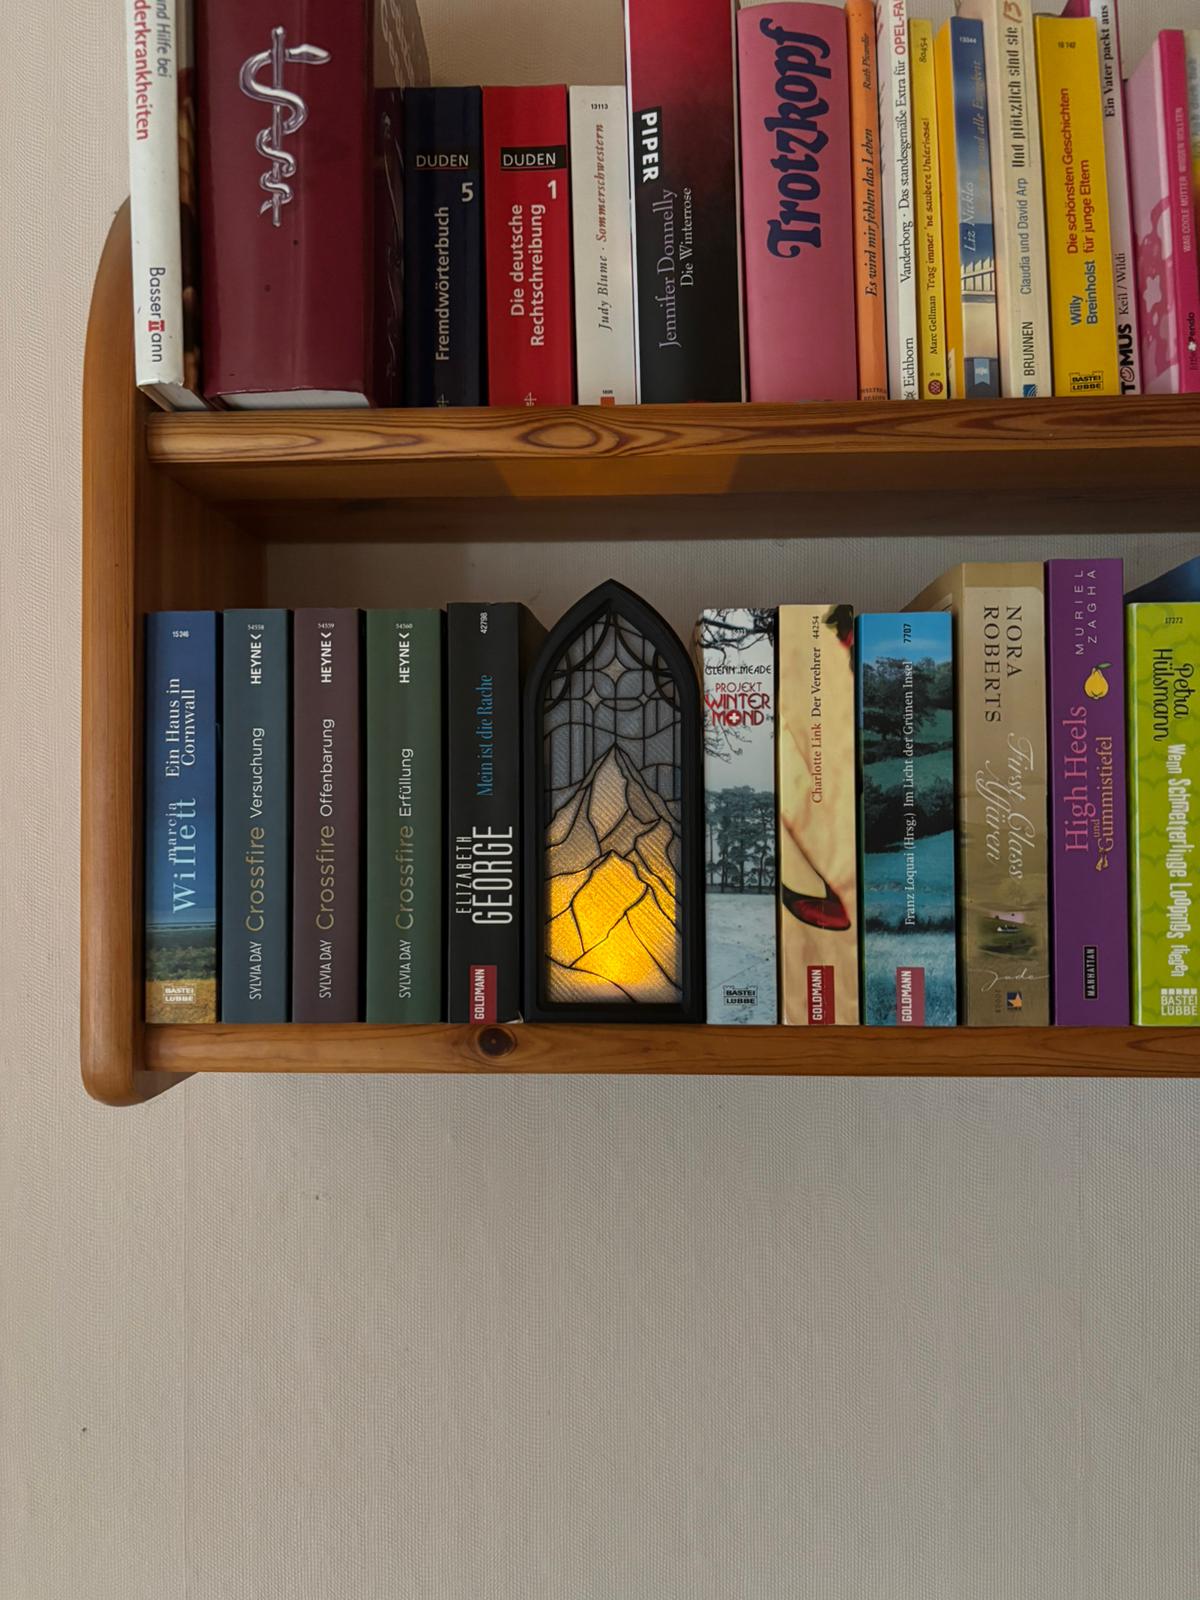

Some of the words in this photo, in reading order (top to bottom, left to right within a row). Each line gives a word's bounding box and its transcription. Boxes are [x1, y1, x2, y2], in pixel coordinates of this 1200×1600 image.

[893, 0, 906, 55] OPEL-FA
[1101, 5, 1110, 24] aus
[157, 24, 171, 54] Hilfe
[1005, 26, 1020, 46] sie
[1100, 28, 1115, 60] packt
[157, 58, 172, 78] bei
[893, 60, 906, 79] für
[1006, 50, 1021, 76] sind
[1102, 63, 1115, 96] Vater
[896, 80, 907, 107] Extra
[1008, 80, 1026, 140] plötzlich
[1104, 97, 1116, 118] Ein
[760, 18, 832, 258] Trotzkopf
[861, 128, 873, 161] Leben
[1060, 88, 1073, 165] Geschichten
[415, 154, 469, 167] DUDEN
[503, 153, 556, 166] DUDEN
[641, 111, 659, 183] PIPER
[896, 110, 912, 186] standesgemäße
[1011, 144, 1026, 168] Und
[461, 182, 474, 202] 5
[547, 180, 557, 199] 1
[594, 123, 608, 242] Sommerschwestern
[862, 162, 875, 186] das
[923, 169, 933, 211] saubere
[1016, 177, 1029, 197] Arp
[1080, 160, 1092, 192] Eltern
[863, 186, 880, 225] fehlen
[898, 189, 909, 209] Das
[961, 182, 976, 226] Nickles
[1017, 199, 1029, 228] David
[1062, 167, 1078, 231] schönsten
[1081, 194, 1096, 232] junge
[653, 189, 677, 275] Donnelly
[680, 187, 693, 260] Winterrose
[864, 226, 876, 247] mir
[964, 231, 976, 251] Liz
[1018, 229, 1030, 253] und
[508, 205, 524, 282] deutsche
[899, 221, 913, 283] Vanderborg
[925, 233, 934, 264] immer
[1067, 233, 1078, 254] Die
[1082, 234, 1094, 254] für
[434, 206, 450, 361] Fremdwörterbuch
[528, 204, 546, 346] Rechtschreibung
[597, 255, 609, 296] Blume
[680, 262, 694, 287] Die
[865, 251, 877, 280] wird
[926, 267, 937, 291] Trag
[1019, 256, 1031, 295] Claudia
[1114, 252, 1126, 281] Wildi
[510, 291, 525, 316] Die
[865, 282, 877, 296] Es
[1085, 260, 1098, 325] Breinholst
[1118, 292, 1129, 315] Keil
[148, 267, 166, 363] Bassermann
[598, 298, 613, 331] Judy
[655, 277, 681, 348] Jennifer
[928, 295, 936, 327] Gellman
[1070, 295, 1083, 325] Willy
[1187, 311, 1196, 342] Pendo
[929, 330, 938, 354] Marc
[1022, 321, 1035, 377] BRUNNEN
[904, 337, 915, 387] Eichborn
[1072, 375, 1101, 383] BASTEI
[480, 612, 488, 634] 42798
[1074, 570, 1085, 655] MURIEL
[1087, 569, 1098, 644] ZAGHA
[903, 623, 912, 643] 7707
[1006, 605, 1023, 680] NORA
[250, 642, 262, 685] HEYNE
[320, 640, 332, 683] HEYNE
[399, 640, 410, 683] HEYNE
[704, 664, 735, 675] GLENN
[740, 664, 771, 675] MEADE
[810, 647, 822, 694] Verehrer
[902, 661, 913, 688] Insel
[983, 605, 1001, 722] ROBERTS
[166, 678, 180, 694] in
[475, 674, 493, 715] Rache
[705, 693, 771, 709] WINTER
[715, 682, 762, 692] PROJEKT
[1152, 649, 1174, 741] Hülsmann
[1173, 662, 1195, 720] Petra
[165, 700, 180, 742] Haus
[712, 710, 765, 727] MOND
[811, 695, 822, 717] Der
[902, 693, 914, 735] Grünen
[181, 689, 195, 766] Cornwall
[476, 718, 493, 740] die
[811, 723, 822, 747] Link
[1063, 706, 1088, 780] Heels
[165, 751, 180, 777] Ein
[477, 743, 493, 759] ist
[903, 737, 914, 757] der
[1166, 743, 1186, 774] Wenn
[250, 727, 265, 818] Versuchung
[319, 719, 335, 817] Offenbarung
[399, 748, 414, 817] Erfüllung
[476, 762, 493, 796] Mein
[811, 751, 822, 804] Charlotte
[903, 761, 914, 790] Licht
[1007, 732, 1034, 801] First
[903, 793, 914, 807] Im
[1096, 736, 1114, 852] Gummistiefel
[903, 812, 917, 850] (Hrsg.)
[975, 760, 1011, 866] Affären
[1064, 786, 1096, 851] High
[1091, 819, 1100, 838] und
[1166, 778, 1194, 878] Schmetterlinge
[165, 802, 177, 863] marcia
[1007, 812, 1035, 880] Class
[173, 798, 196, 914] Willett
[904, 852, 917, 890] Loquai
[246, 826, 265, 932] Crossfire
[316, 825, 335, 930] Crossfire
[395, 825, 414, 930] Crossfire
[456, 836, 472, 914] ELIZABETH
[472, 826, 513, 925] GEORGE
[904, 893, 916, 925] Franz
[1167, 883, 1192, 939] Loopings
[249, 941, 262, 961] DAY
[319, 940, 332, 960] DAY
[399, 940, 412, 960] DAY
[1168, 945, 1190, 977] fliegen
[249, 963, 262, 1000] SYLVIA
[319, 963, 332, 999] SYLVIA
[399, 963, 412, 999] SYLVIA
[1087, 948, 1096, 997] MANHATTAN
[474, 968, 485, 1020] GOLDMANN
[812, 969, 823, 1021] GOLDMANN
[902, 970, 913, 1022] GOLDMANN
[1161, 995, 1198, 1005] BASTEI
